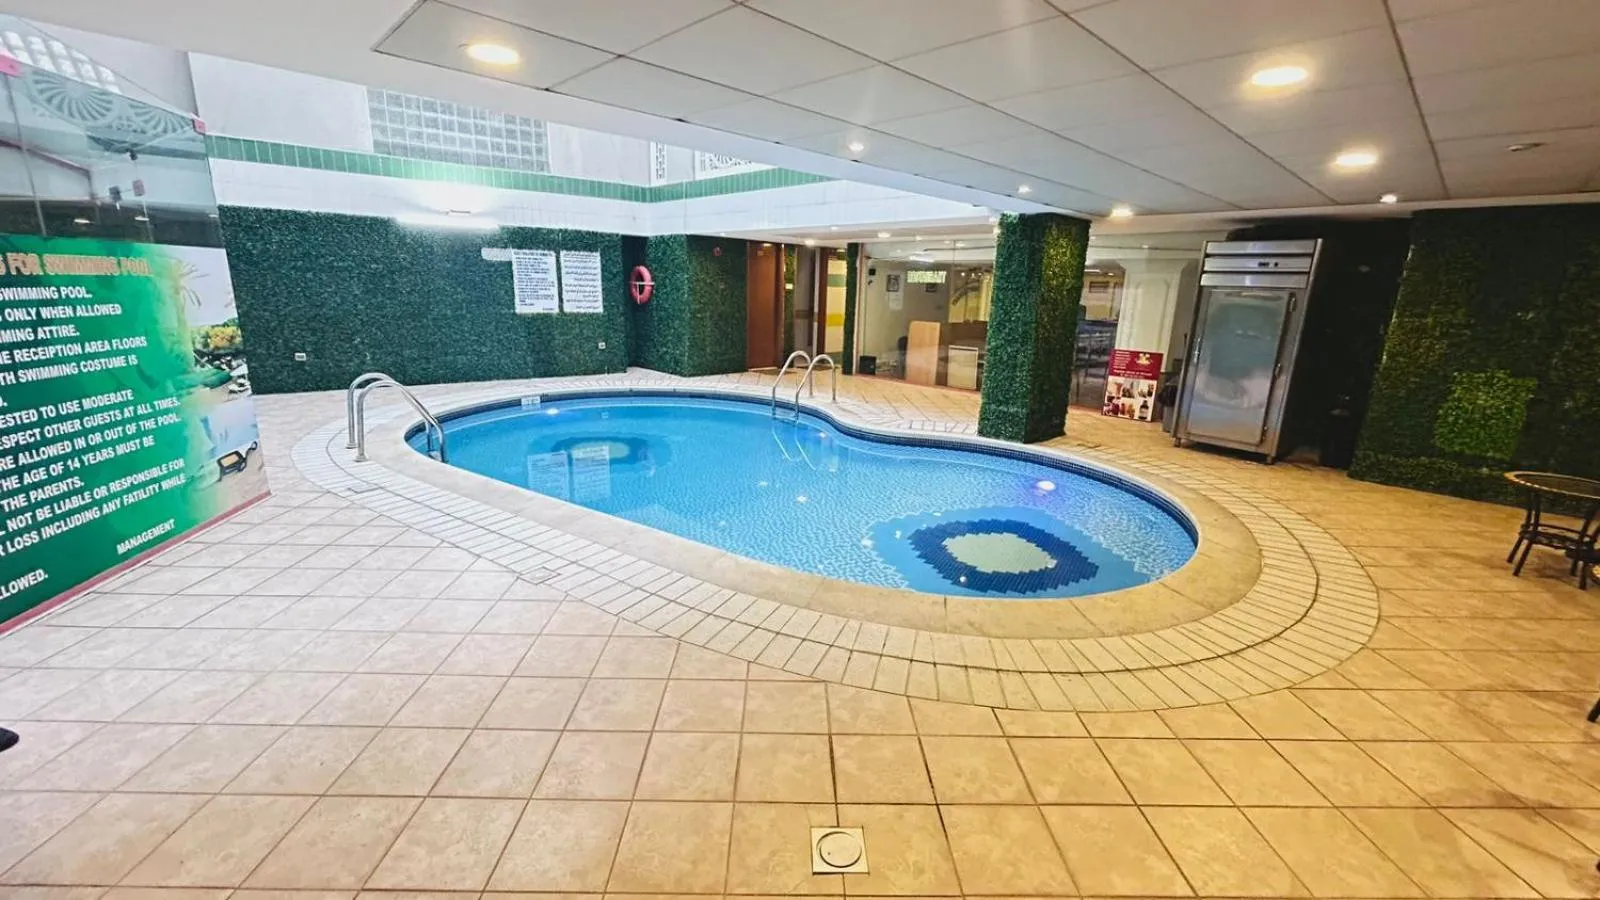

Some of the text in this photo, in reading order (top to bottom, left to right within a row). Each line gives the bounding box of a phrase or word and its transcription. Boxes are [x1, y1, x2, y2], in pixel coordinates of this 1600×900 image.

[6, 252, 44, 274] FOR
[60, 286, 93, 298] POOL.
[4, 307, 37, 321] ONLY
[39, 305, 75, 319] WHEN
[76, 303, 123, 316] ALLOWED
[0, 324, 80, 343] MING ATTIRE.
[13, 342, 83, 362] RECEIPTION
[84, 340, 112, 353] AREA
[111, 335, 148, 349] FLOORS
[17, 362, 79, 382] SWIMMING
[79, 355, 127, 372] COSTUME
[127, 354, 139, 365] IS
[39, 404, 57, 418] TO
[58, 399, 81, 414] USE
[81, 388, 134, 409] MODERATE
[43, 418, 82, 437] OTHER
[83, 408, 122, 427] GUESTS
[122, 406, 135, 418] AT
[136, 402, 154, 415] ALL
[153, 396, 181, 410] TIMES.
[18, 440, 73, 466] ALLOWED
[73, 435, 87, 449] IN
[87, 432, 103, 445] OR
[103, 426, 124, 440] OUT
[124, 422, 138, 434] OF
[138, 418, 157, 431] THE
[22, 466, 48, 485] AGE
[49, 461, 65, 476] OF
[66, 456, 81, 471] 14
[81, 446, 115, 466] YEARS
[115, 438, 141, 455] MUST
[142, 434, 156, 447] BE
[0, 476, 85, 511] THE PARENTS.
[6, 458, 186, 532] NOT BE LIABLE OR RESPONSIBLE FOR
[6, 530, 40, 553] LOSS
[41, 506, 101, 539] INCLUDING
[102, 496, 122, 515] ANY
[122, 482, 161, 506] FATILITY
[160, 473, 187, 490] WHILE
[116, 518, 176, 555] MANAGEMENT
